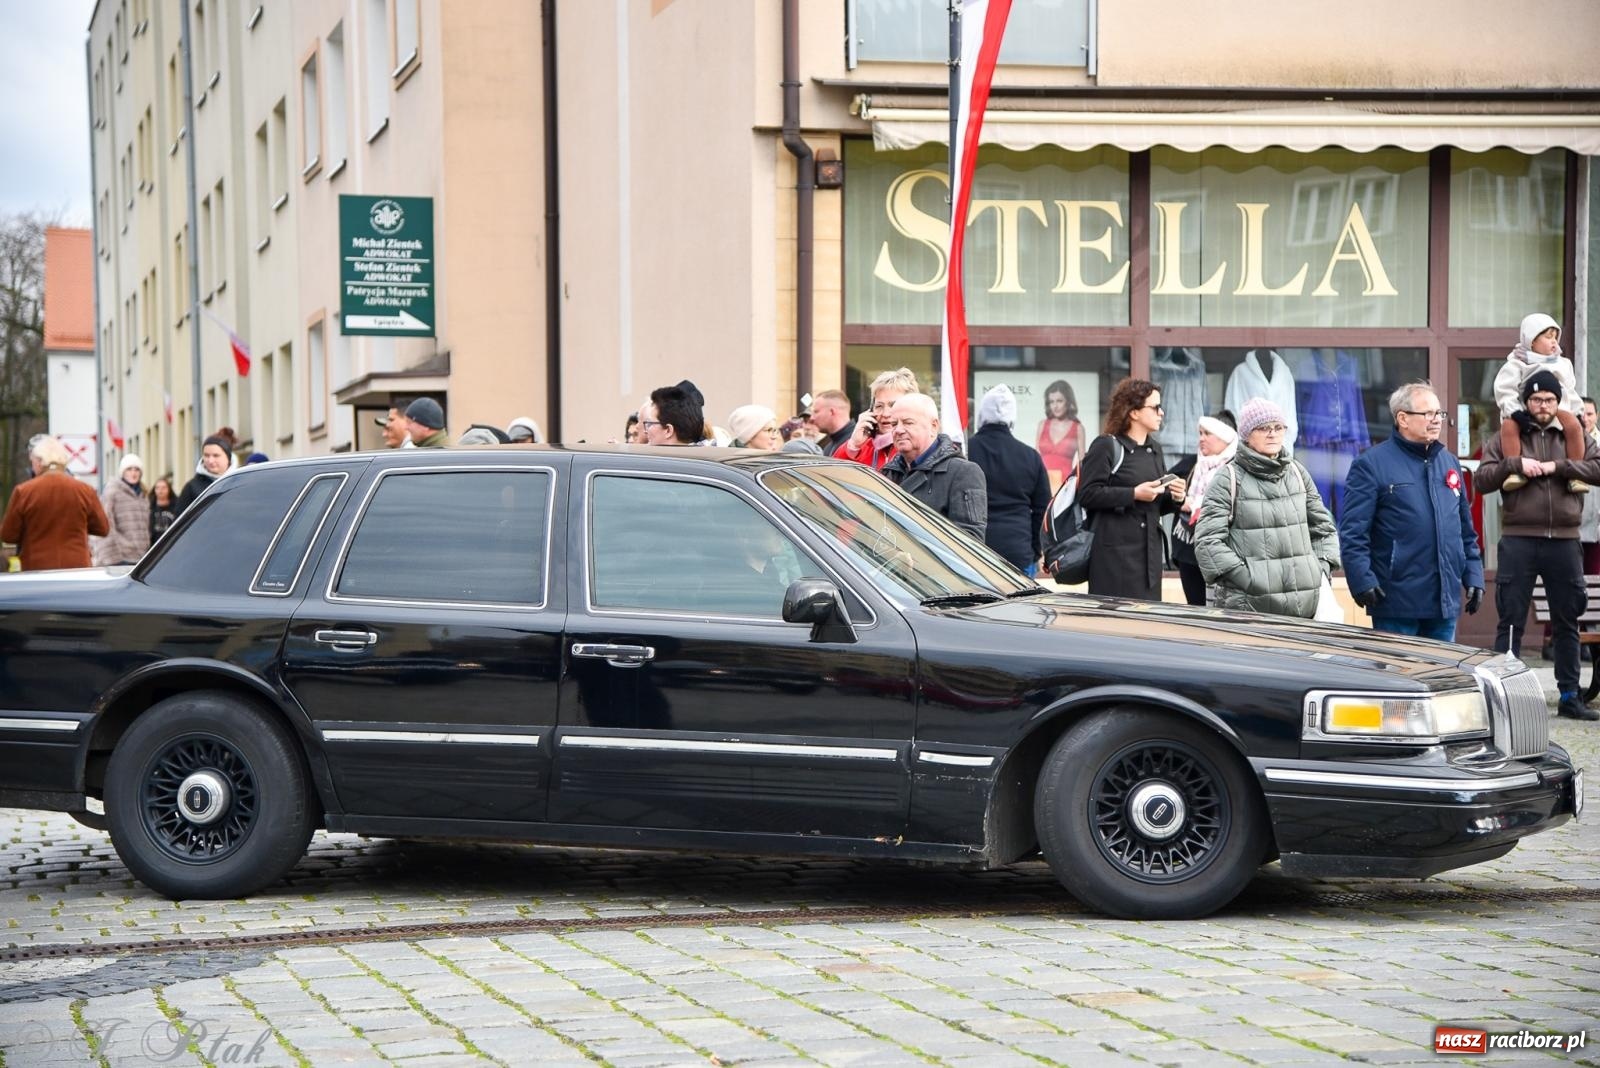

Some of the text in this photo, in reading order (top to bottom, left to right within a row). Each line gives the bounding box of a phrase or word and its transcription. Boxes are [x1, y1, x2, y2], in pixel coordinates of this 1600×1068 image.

[873, 169, 1398, 296] STELLA
[363, 250, 412, 258] ADWOKAT
[354, 262, 385, 272] Stefan
[363, 273, 412, 282] ADWOKAT
[346, 286, 428, 297] Patrycja Mazurek
[363, 297, 412, 306] ADWOKAT
